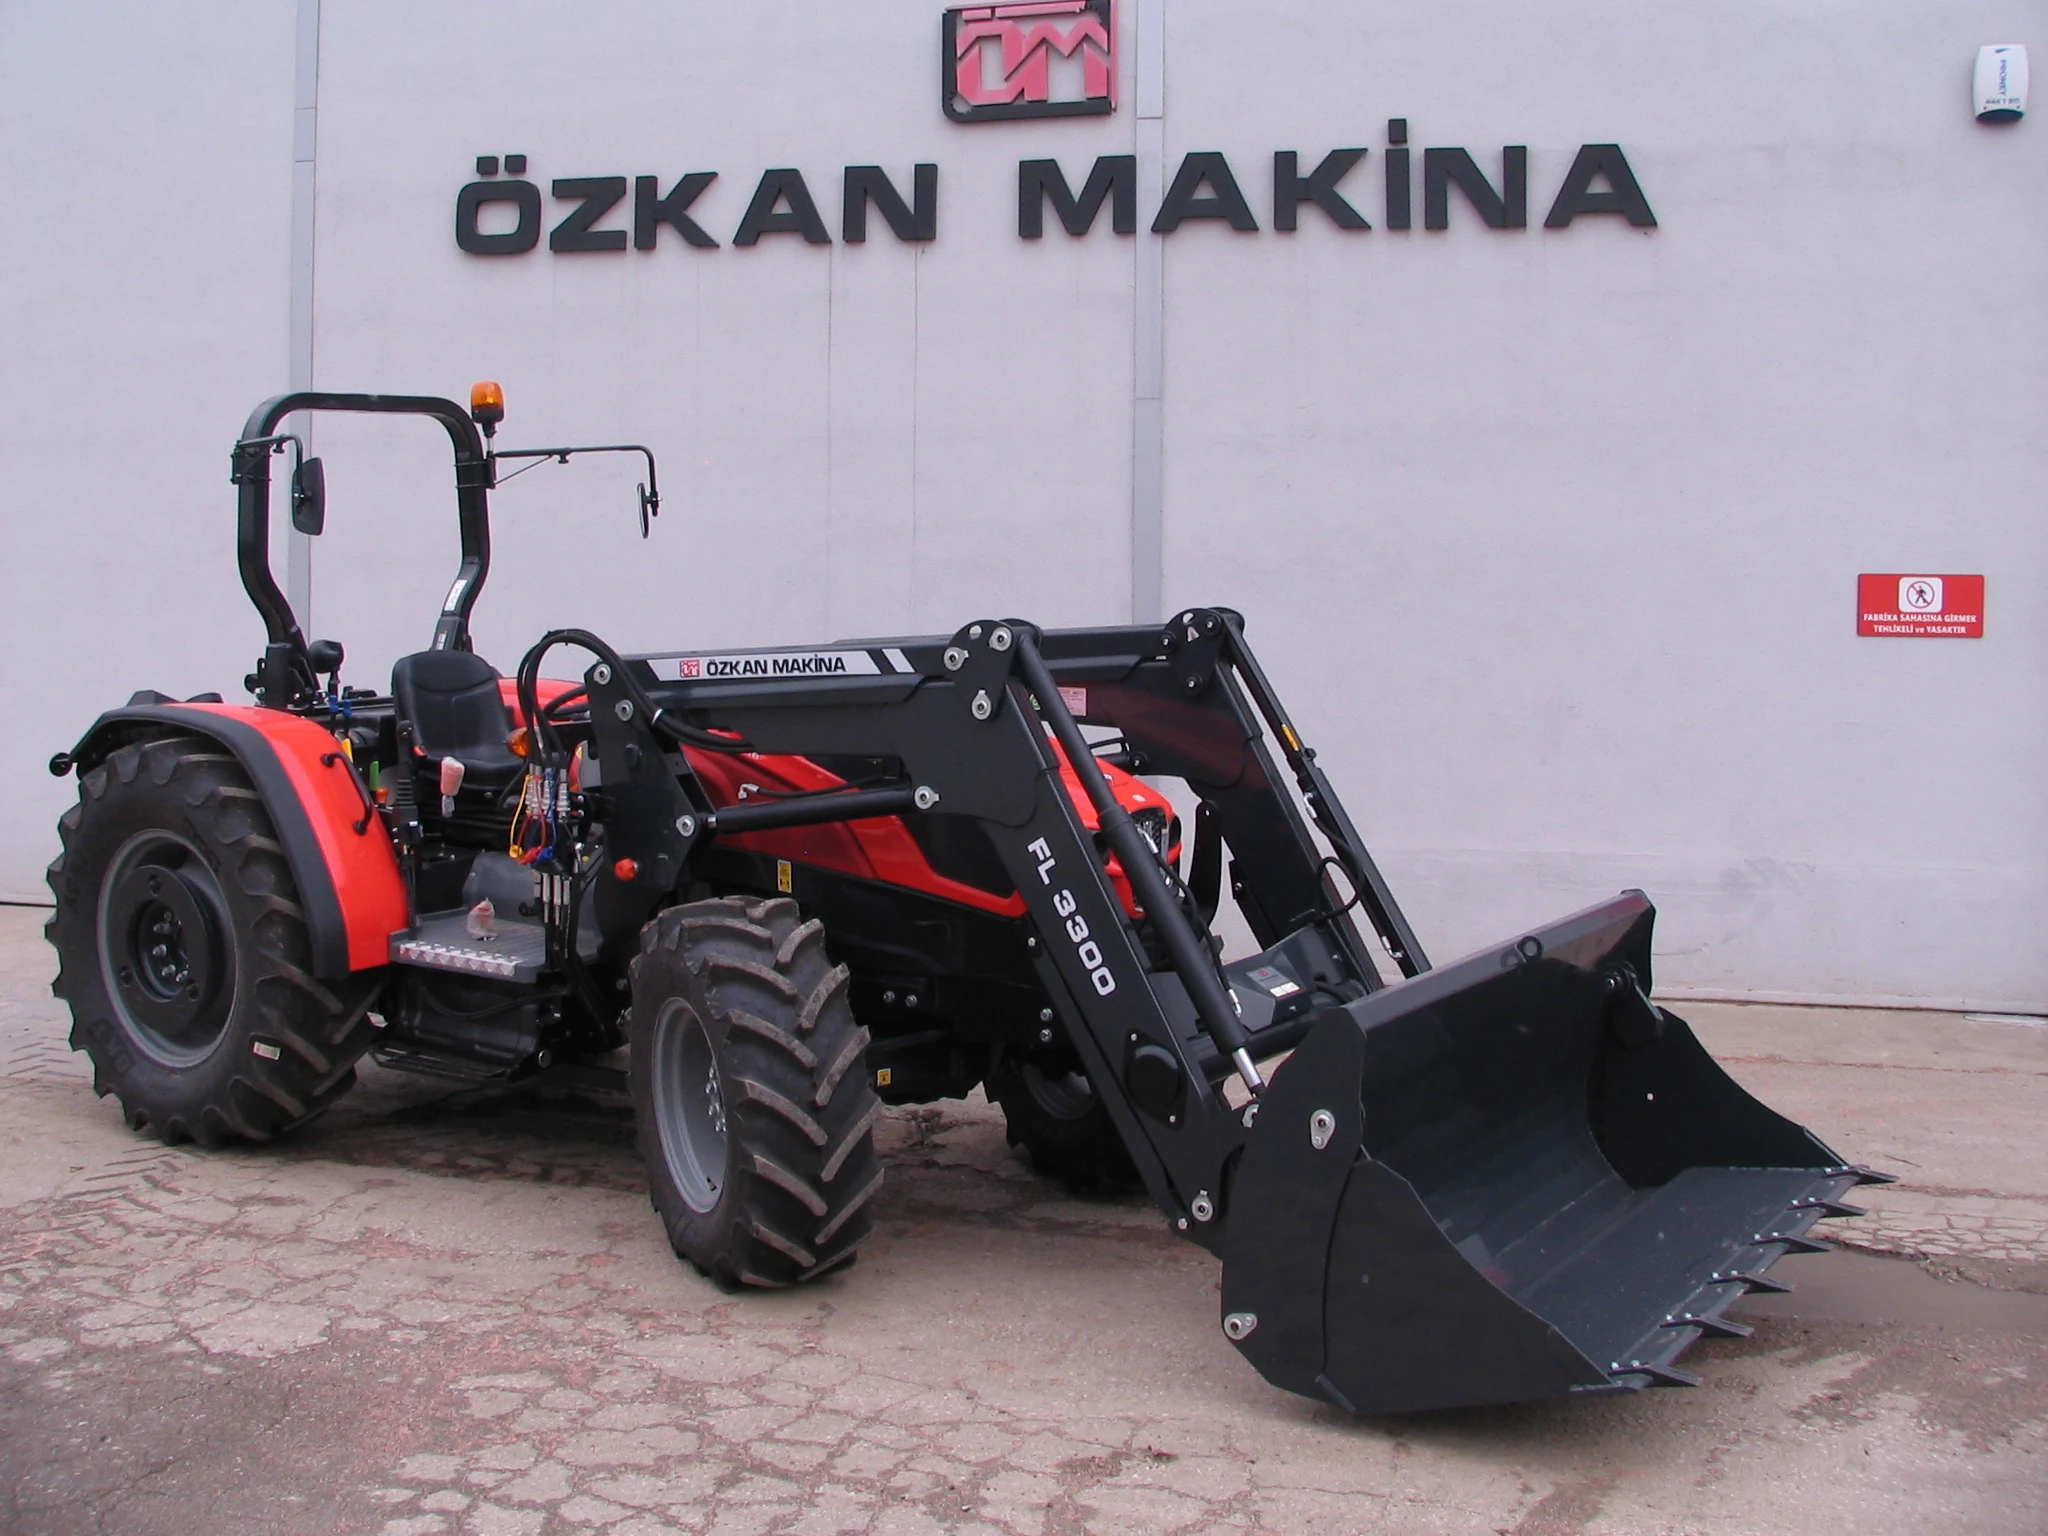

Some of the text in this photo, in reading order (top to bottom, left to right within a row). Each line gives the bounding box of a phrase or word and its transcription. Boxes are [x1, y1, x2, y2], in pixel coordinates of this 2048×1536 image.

[456, 118, 1658, 256] ÖZKAN MAKİNA
[1863, 612, 1977, 623] FABRİKA SAHASINA GİRMEK
[1873, 624, 1966, 634] TEHLİKELİ ve YASAKTIR
[706, 657, 768, 676] ÖZKAN
[772, 653, 847, 675] MAKİNA
[1027, 836, 1116, 997] FL 3300
[90, 1021, 133, 1073] BKT
